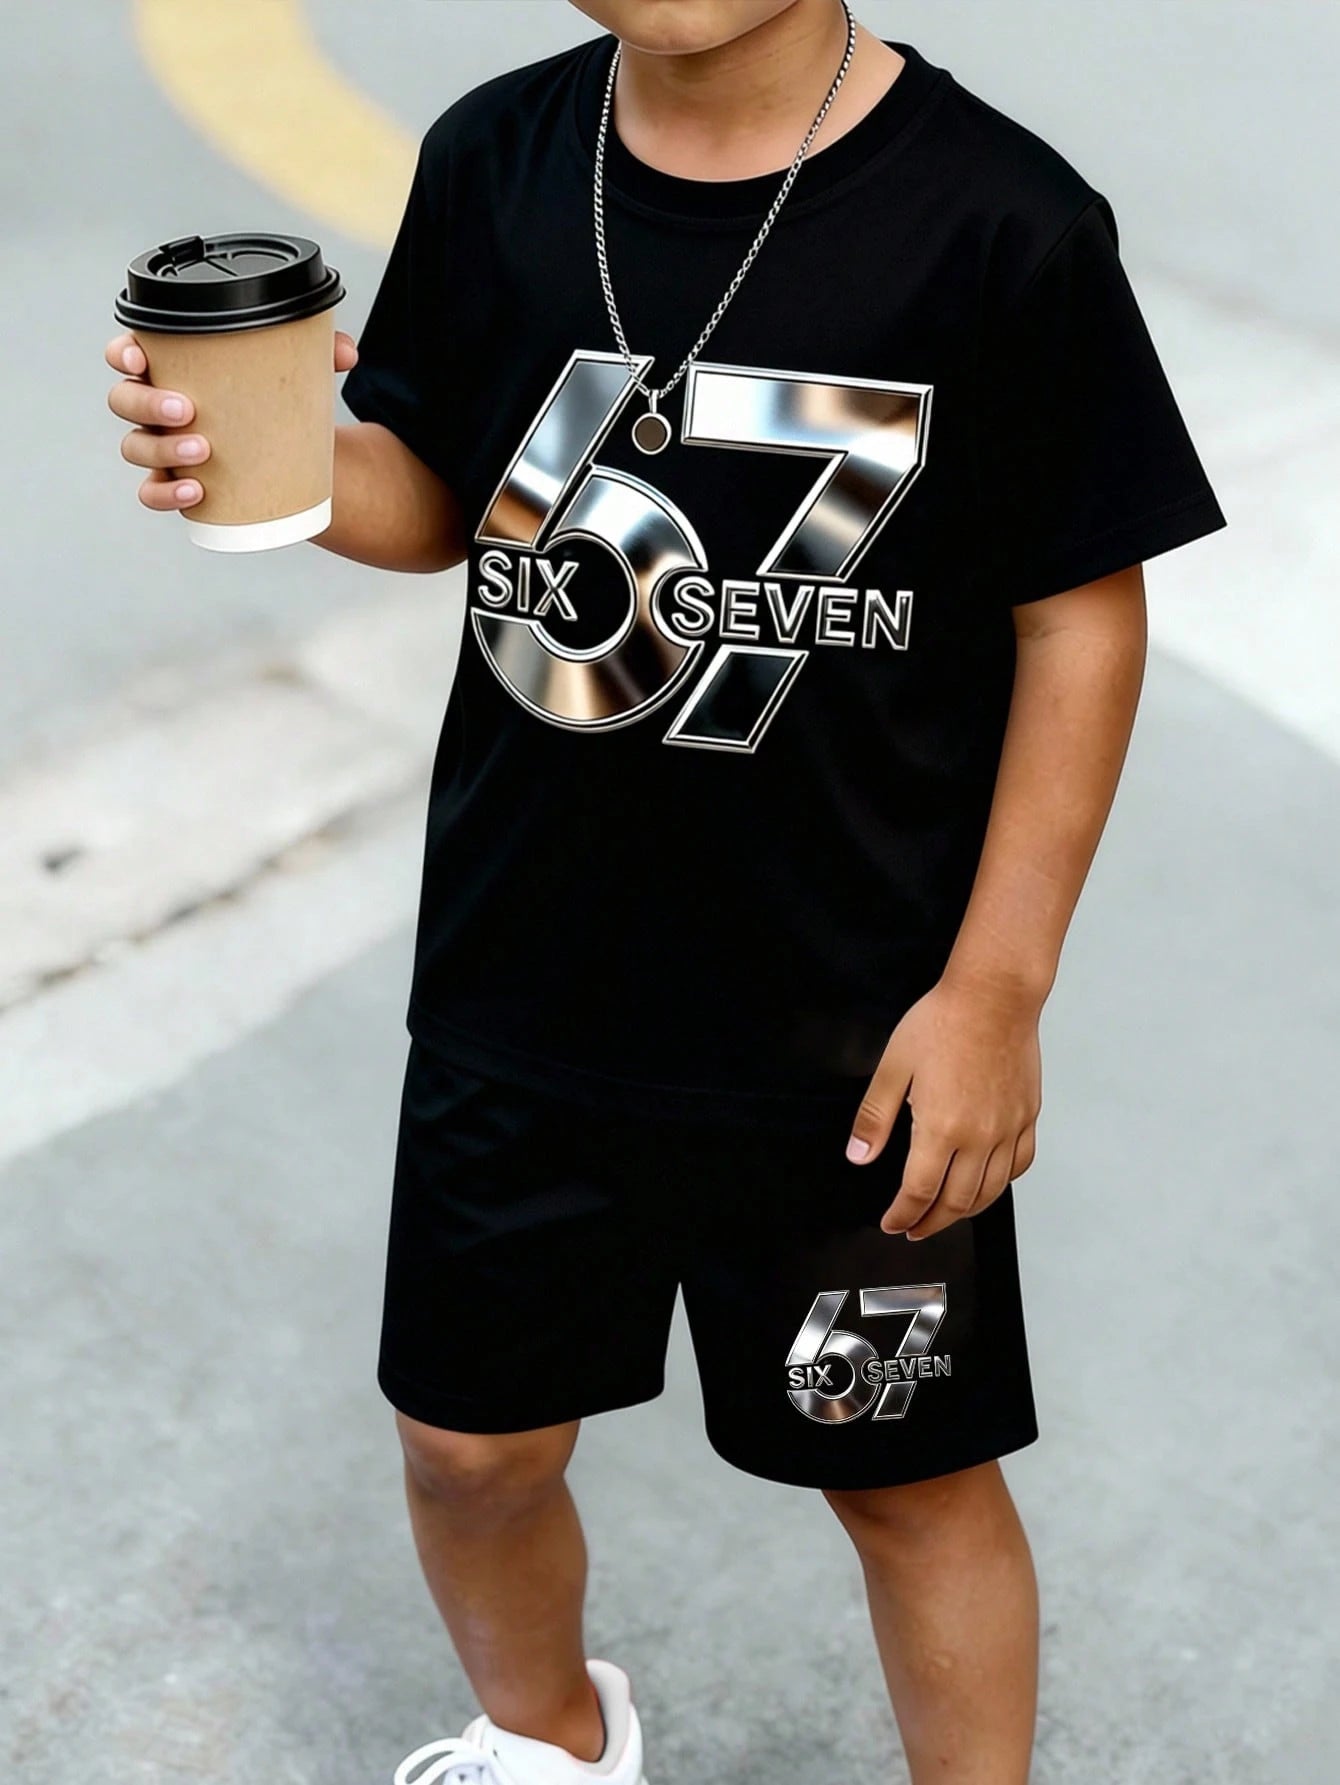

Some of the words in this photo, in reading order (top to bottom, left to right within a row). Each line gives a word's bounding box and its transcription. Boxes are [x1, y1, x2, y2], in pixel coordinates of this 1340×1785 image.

[470, 349, 934, 754] 67
[478, 550, 579, 621] SIX
[671, 576, 914, 650] SEVEN
[785, 1283, 947, 1424] 67
[788, 1364, 833, 1389] SIX
[867, 1354, 952, 1383] SEVEN
